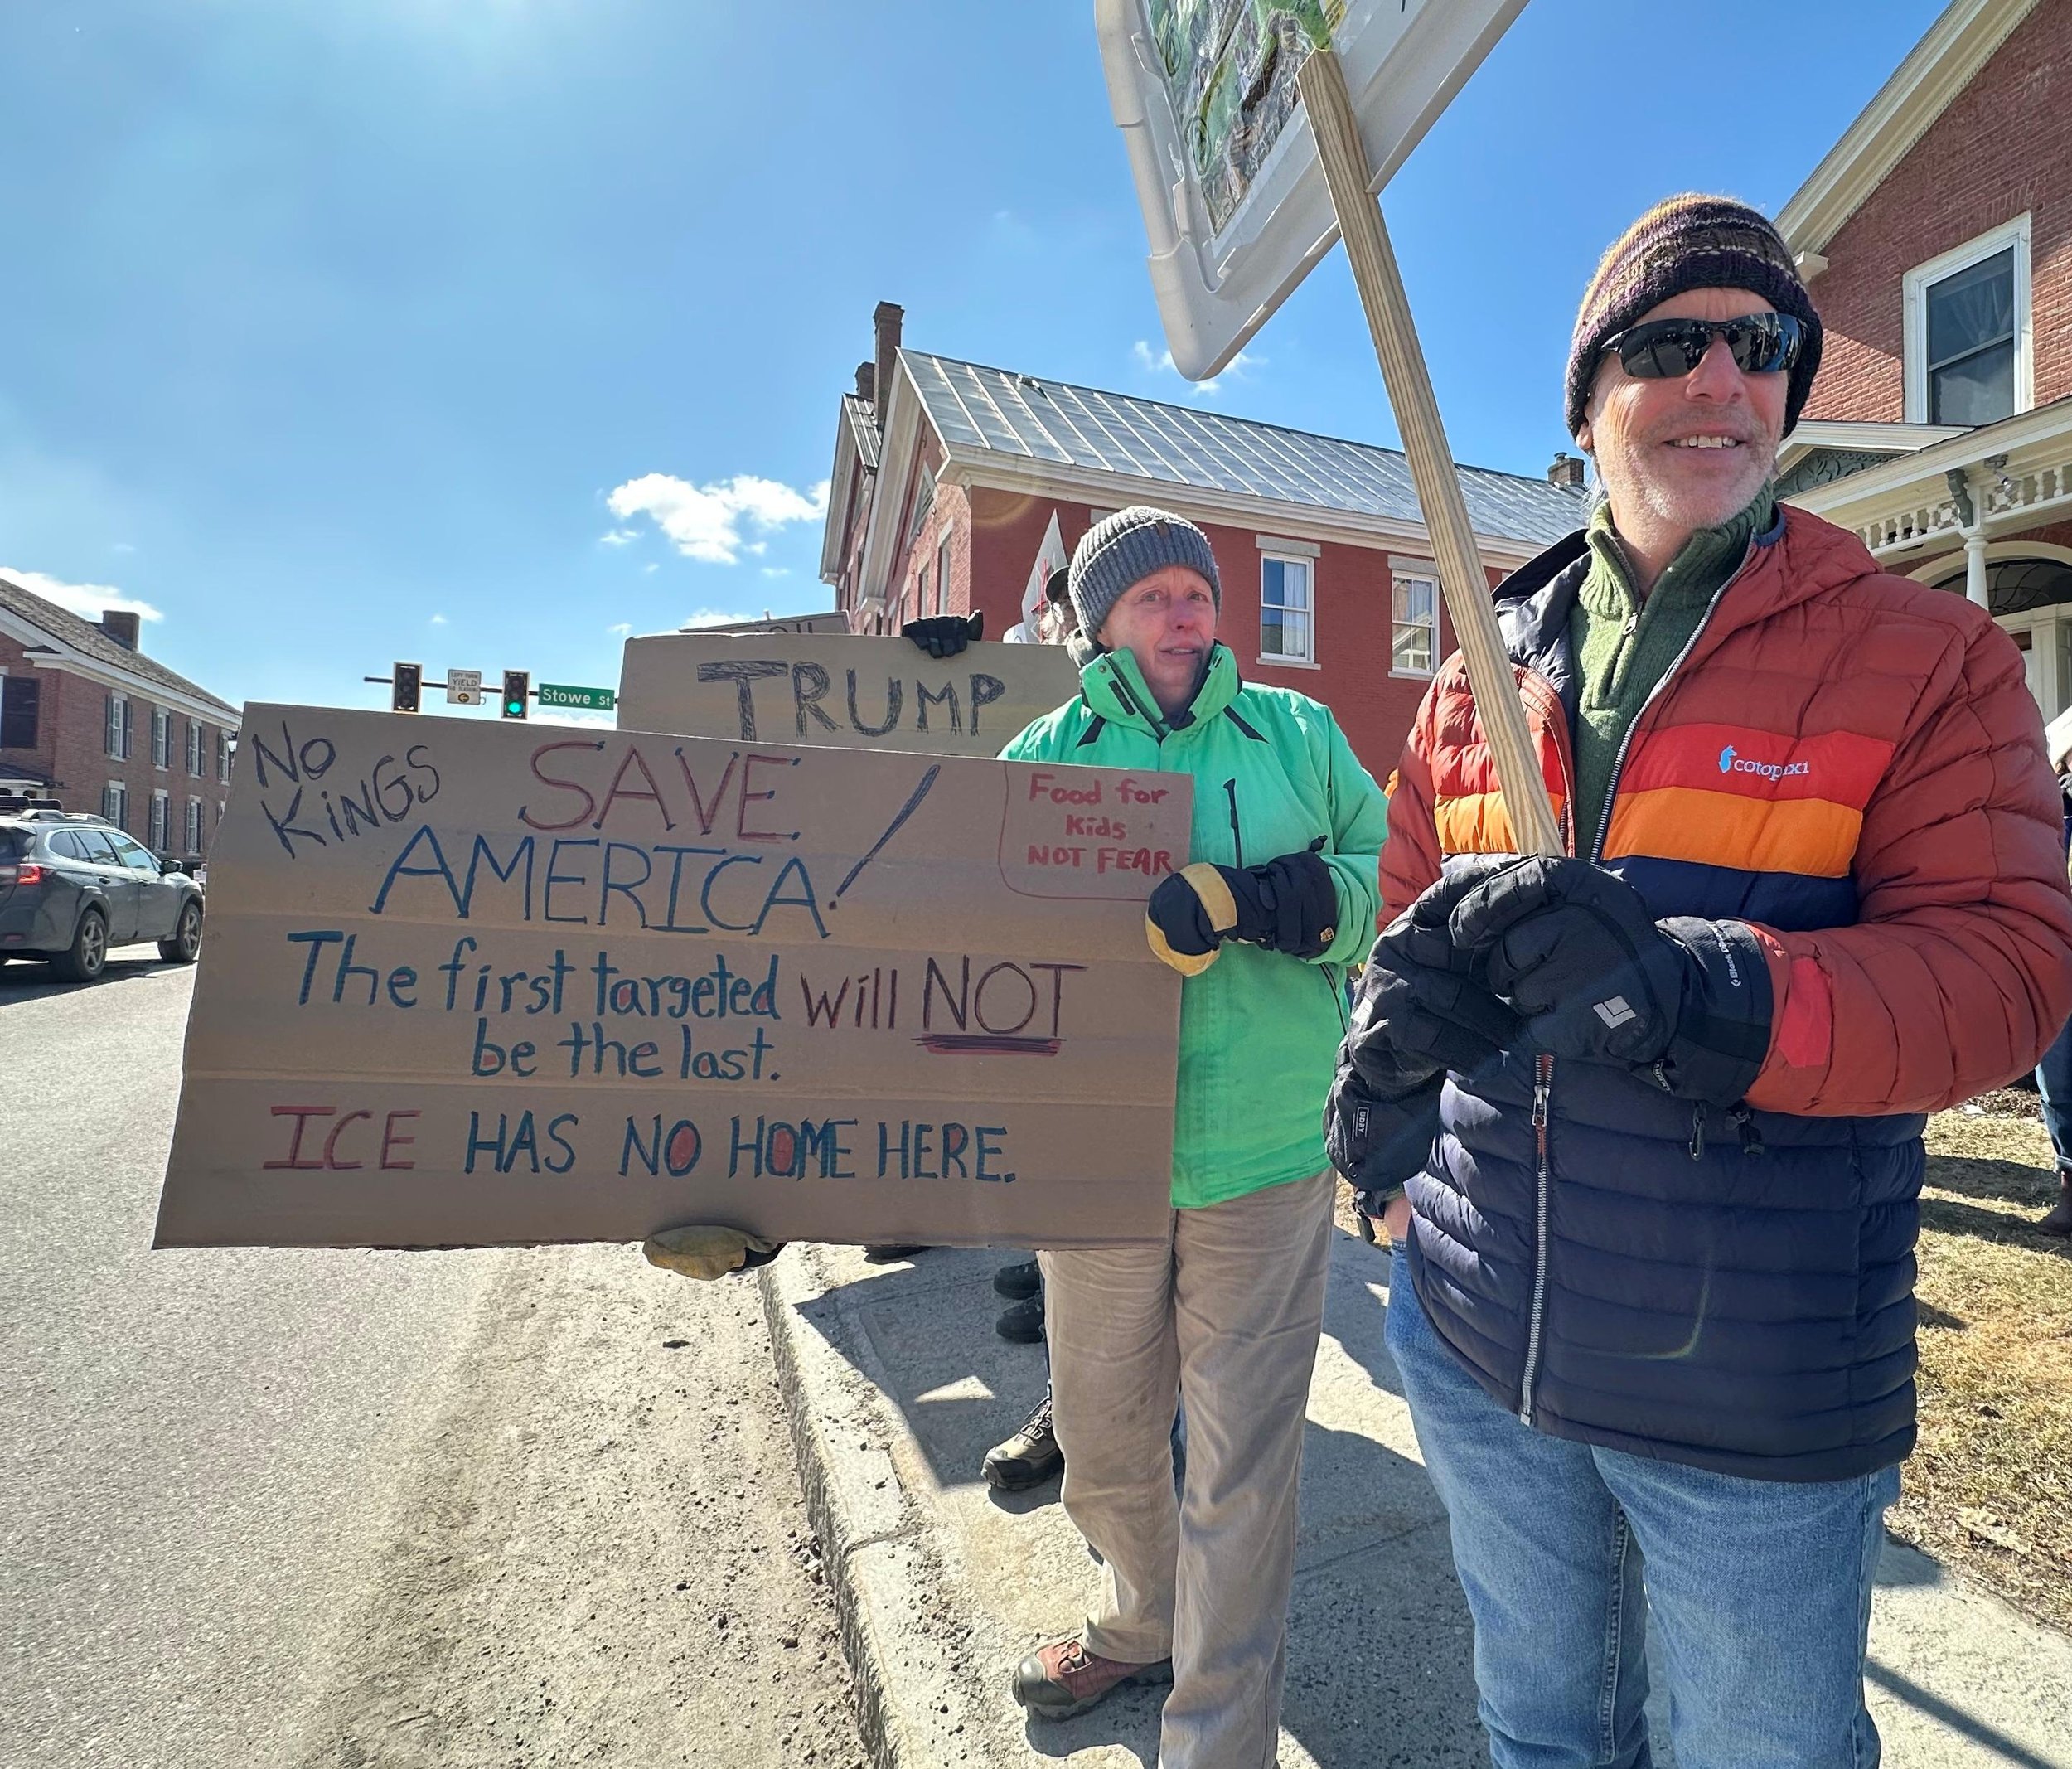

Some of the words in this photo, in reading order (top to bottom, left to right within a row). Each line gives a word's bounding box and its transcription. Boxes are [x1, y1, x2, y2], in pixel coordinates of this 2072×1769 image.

[452, 678, 477, 687] YIELD
[543, 688, 591, 705] Stowe
[598, 695, 610, 706] St
[697, 660, 1005, 741] TRUMP
[518, 740, 801, 842] SAVE
[1029, 773, 1102, 806] Food
[1115, 778, 1169, 805] for
[1027, 845, 1087, 867] NOT
[1097, 847, 1174, 875] FEAR
[287, 930, 418, 1008] The
[438, 937, 576, 1015] first
[591, 950, 782, 1020] targeted
[922, 955, 1089, 1037] NOT
[471, 1017, 537, 1078] be
[557, 1022, 664, 1078] the
[681, 1025, 782, 1081] last.
[262, 1106, 423, 1170] ICE
[463, 1110, 579, 1174] HAS
[618, 1114, 702, 1177] NO
[729, 1115, 859, 1181] HOME
[877, 1120, 1017, 1183] HERE.
